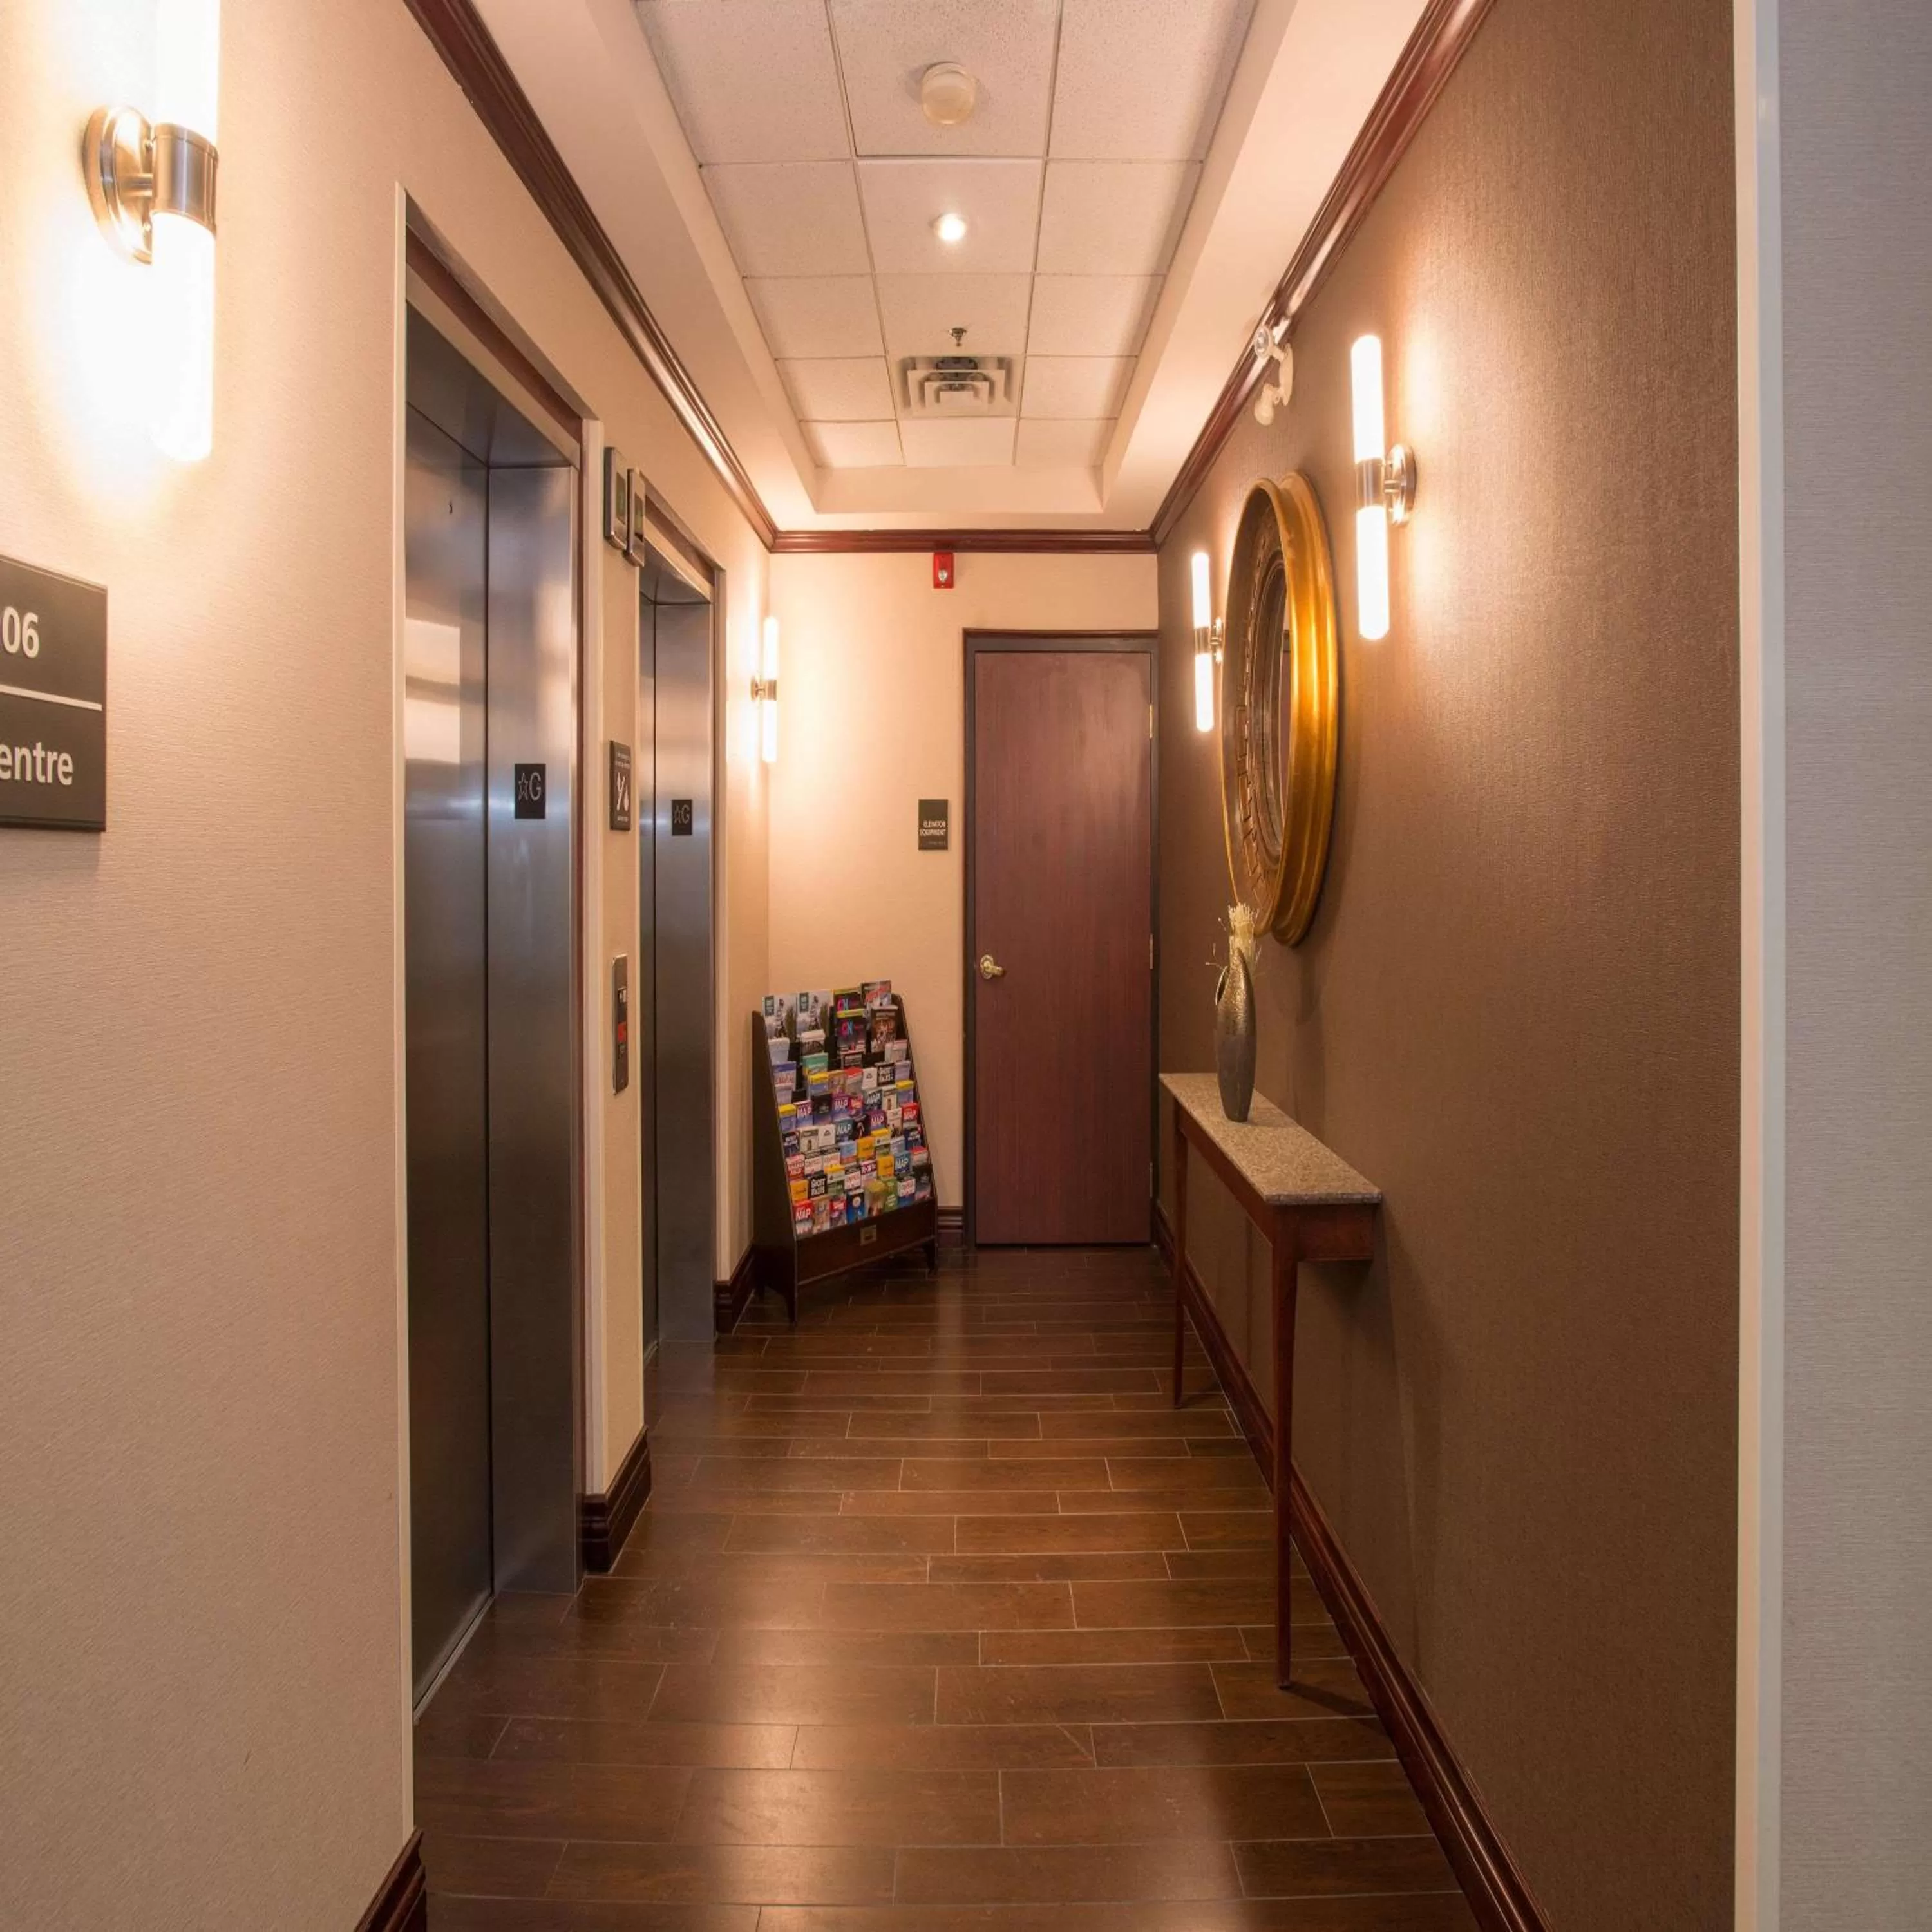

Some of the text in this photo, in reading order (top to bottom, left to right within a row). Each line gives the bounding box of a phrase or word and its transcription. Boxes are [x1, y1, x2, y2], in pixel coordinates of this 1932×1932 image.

[1, 606, 40, 659] 06
[0, 742, 73, 786] entre
[529, 772, 542, 801] G
